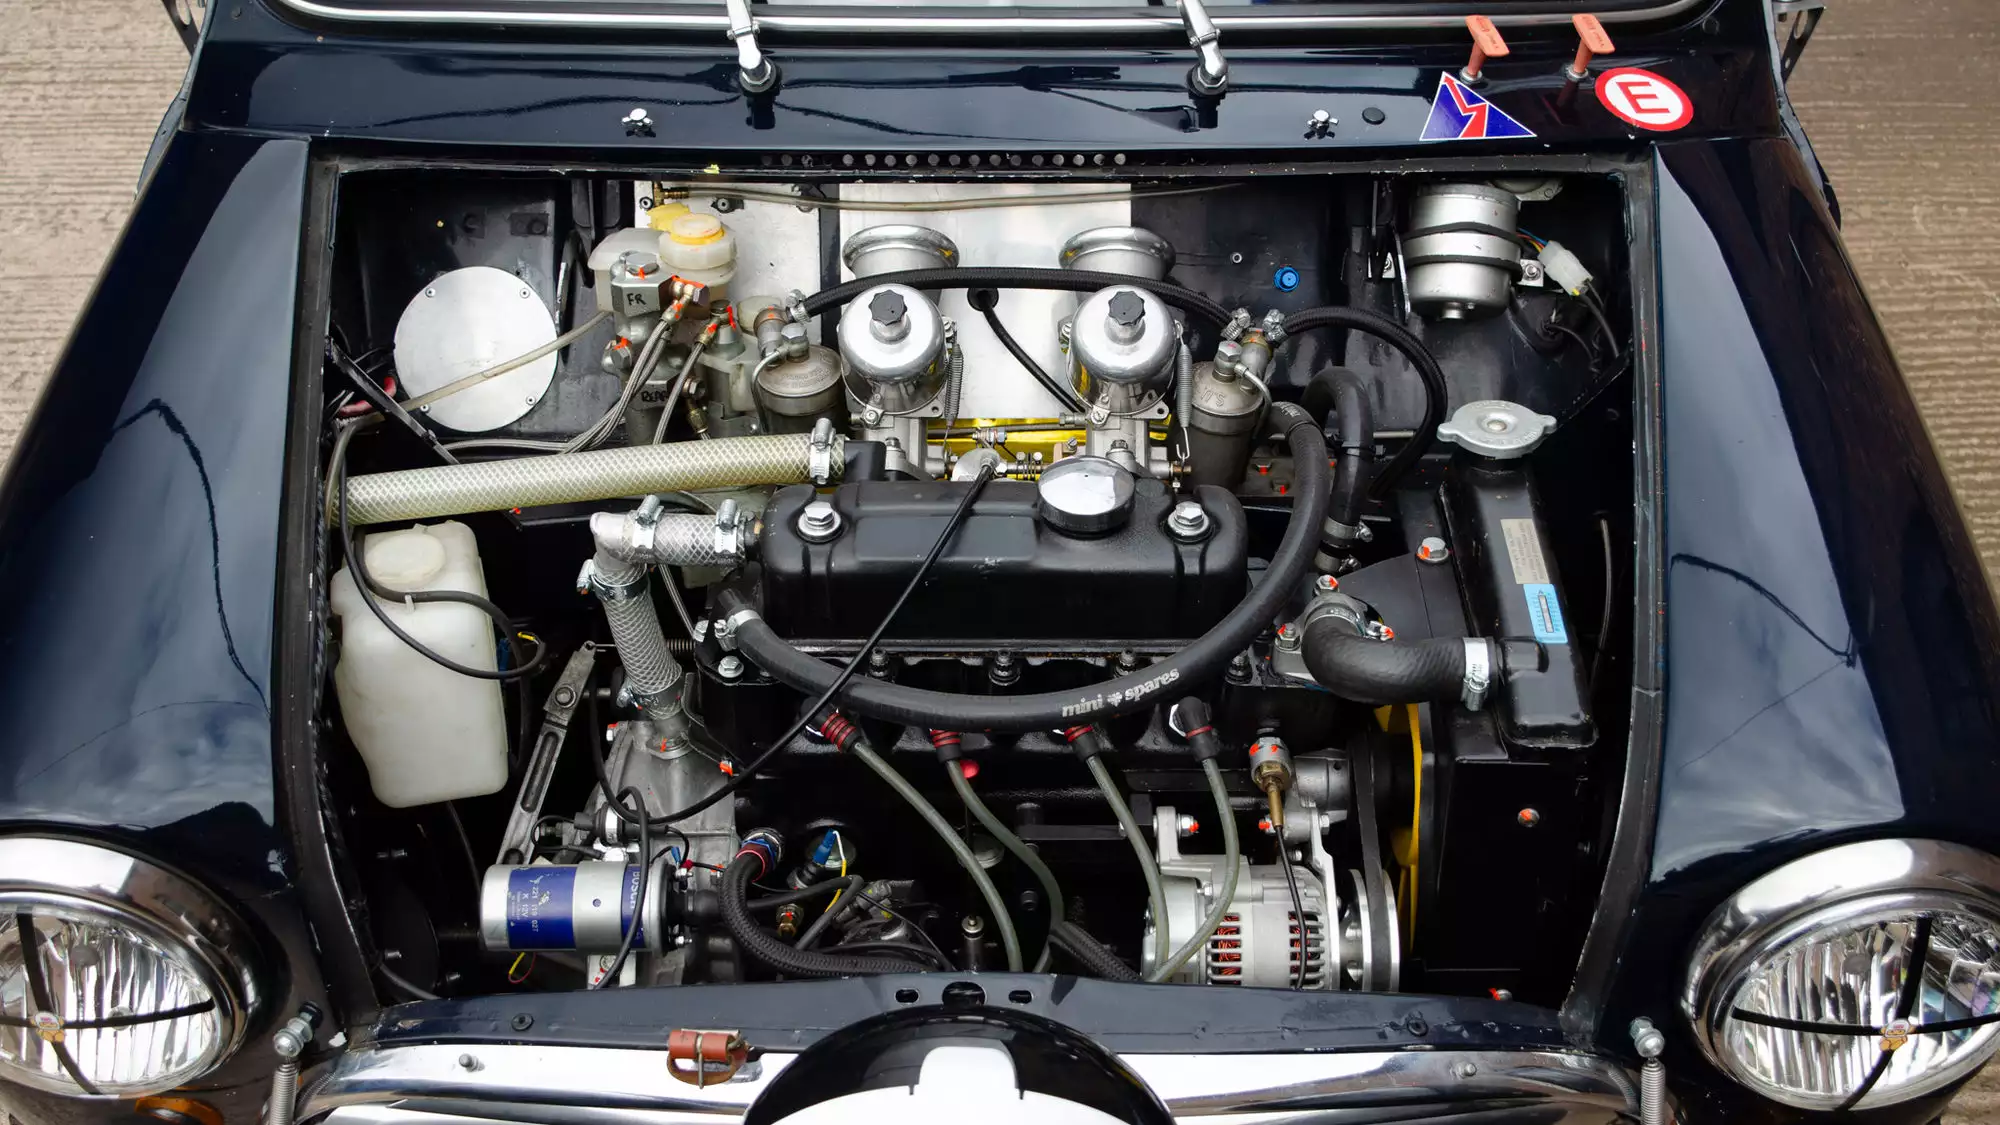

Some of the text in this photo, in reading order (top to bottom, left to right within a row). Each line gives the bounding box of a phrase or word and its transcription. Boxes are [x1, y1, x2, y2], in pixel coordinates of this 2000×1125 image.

[1616, 81, 1670, 114] E
[626, 292, 647, 306] FR
[1062, 668, 1180, 717] mini spares
